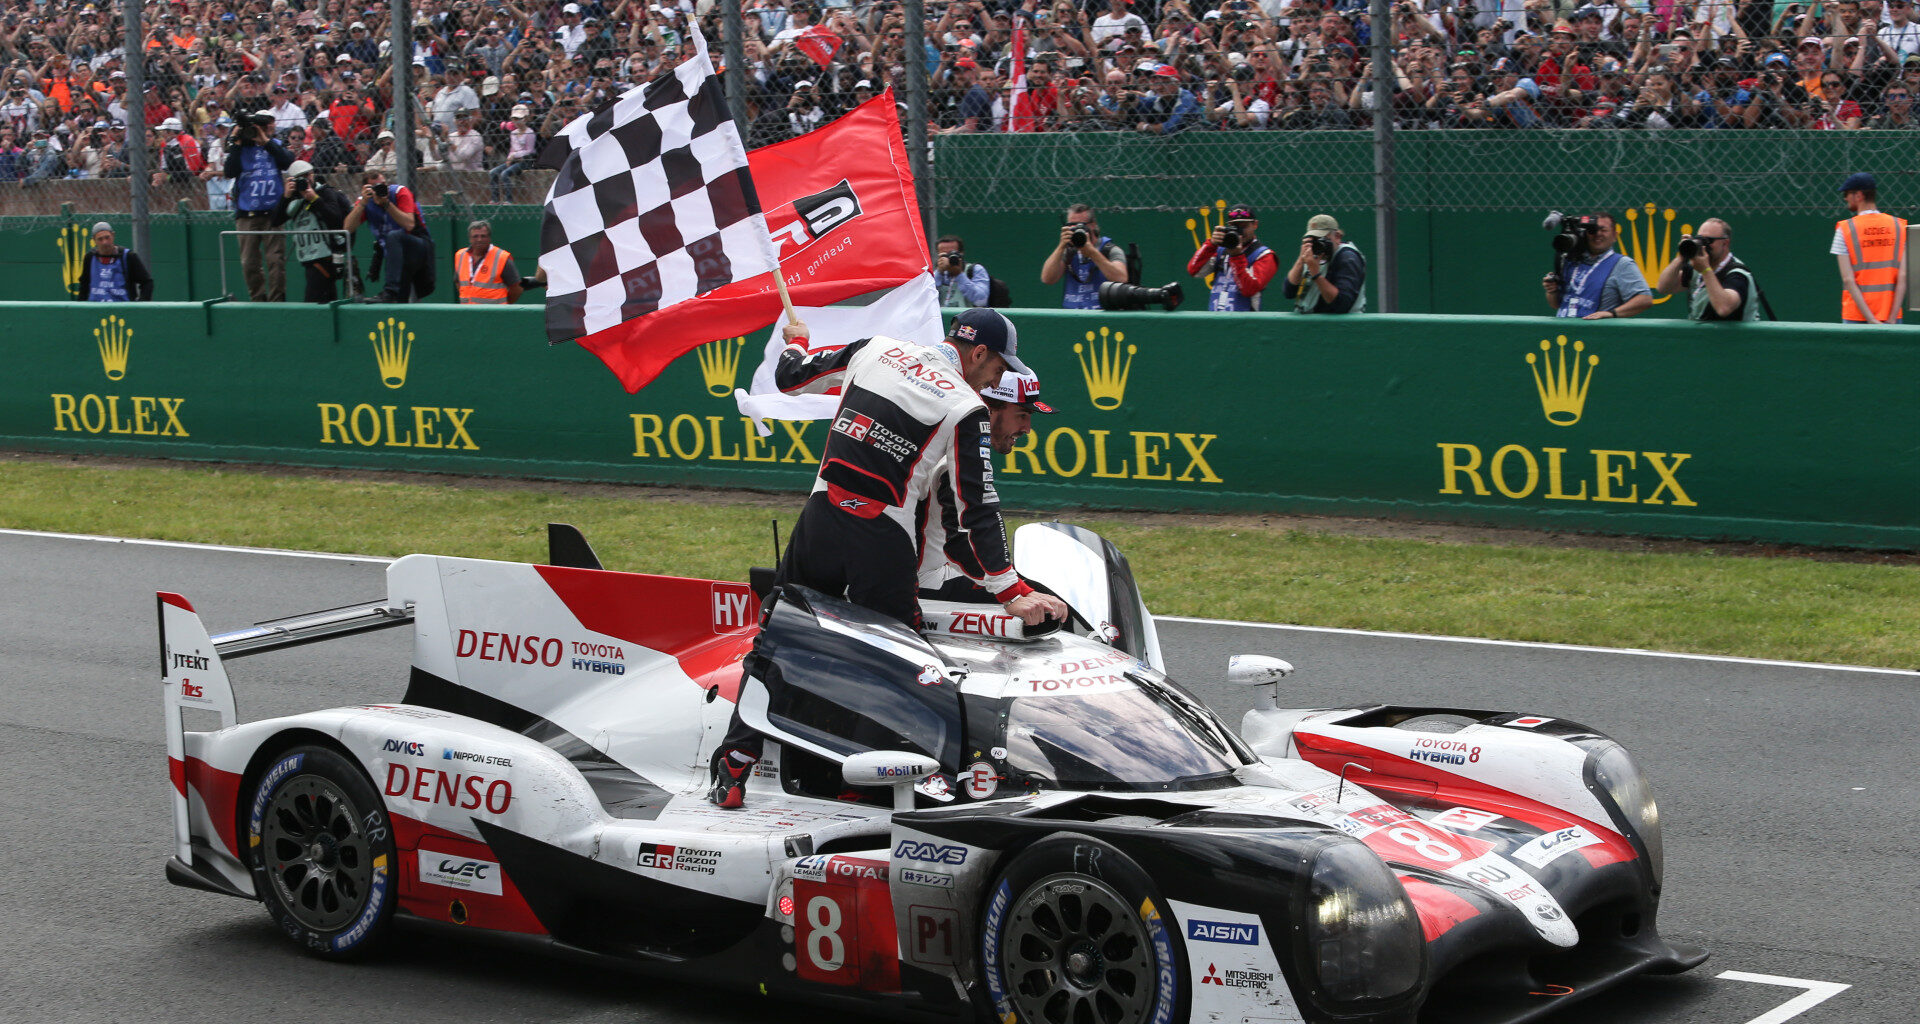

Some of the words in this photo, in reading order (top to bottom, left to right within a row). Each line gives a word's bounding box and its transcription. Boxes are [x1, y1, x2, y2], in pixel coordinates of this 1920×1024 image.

[250, 181, 276, 197] 272
[878, 355, 907, 377] TOYOTA
[884, 347, 956, 390] DENSO
[51, 393, 190, 438] ROLEX
[317, 403, 480, 451] ROLEX
[629, 412, 820, 464] ROLEX
[833, 417, 867, 440] GR
[873, 421, 918, 452] TOYOTA
[865, 436, 904, 463] Racing
[868, 429, 910, 456] GAZOO
[1001, 426, 1223, 484] ROLEX
[1436, 442, 1698, 507] ROLEX
[714, 592, 749, 627] HY
[948, 611, 1014, 637] ZENT
[455, 628, 564, 668] DENSO
[571, 641, 625, 660] TOYOTA
[173, 653, 210, 671] JTEKT
[572, 657, 626, 676] HYBRID
[1060, 650, 1130, 675] DENSO
[1028, 674, 1128, 692] TOYOTA
[382, 738, 424, 757] ADVICS
[453, 750, 485, 763] NIPPON
[486, 756, 513, 768] STEEL
[1409, 749, 1466, 766] HYBRID
[1415, 737, 1467, 752] TOYOTA
[1468, 746, 1482, 763] 8
[877, 765, 910, 777] Mobil
[912, 764, 923, 775] 1
[974, 769, 989, 792] E
[254, 757, 298, 817] MICHELIN
[384, 762, 513, 815] DENSO
[363, 809, 387, 845] RR
[1540, 829, 1582, 850] WEC
[678, 846, 722, 858] TOYOTA
[894, 840, 968, 865] RAYS
[1388, 827, 1462, 862] 8
[439, 859, 490, 880] WEC
[637, 852, 674, 869] GR
[675, 863, 715, 875] Racing
[676, 855, 717, 865] GAZOO
[832, 859, 889, 881] TOTAL
[1073, 844, 1103, 880] FR
[1503, 883, 1537, 901] ZENT
[337, 887, 382, 949] MICHELIN
[806, 895, 845, 972] 8
[917, 914, 953, 957] P1
[984, 889, 1005, 994] MICHELIN
[1154, 941, 1172, 1024] MICHEL
[1225, 969, 1274, 982] MITSUBISHI
[1225, 978, 1267, 989] ELECTRIC
